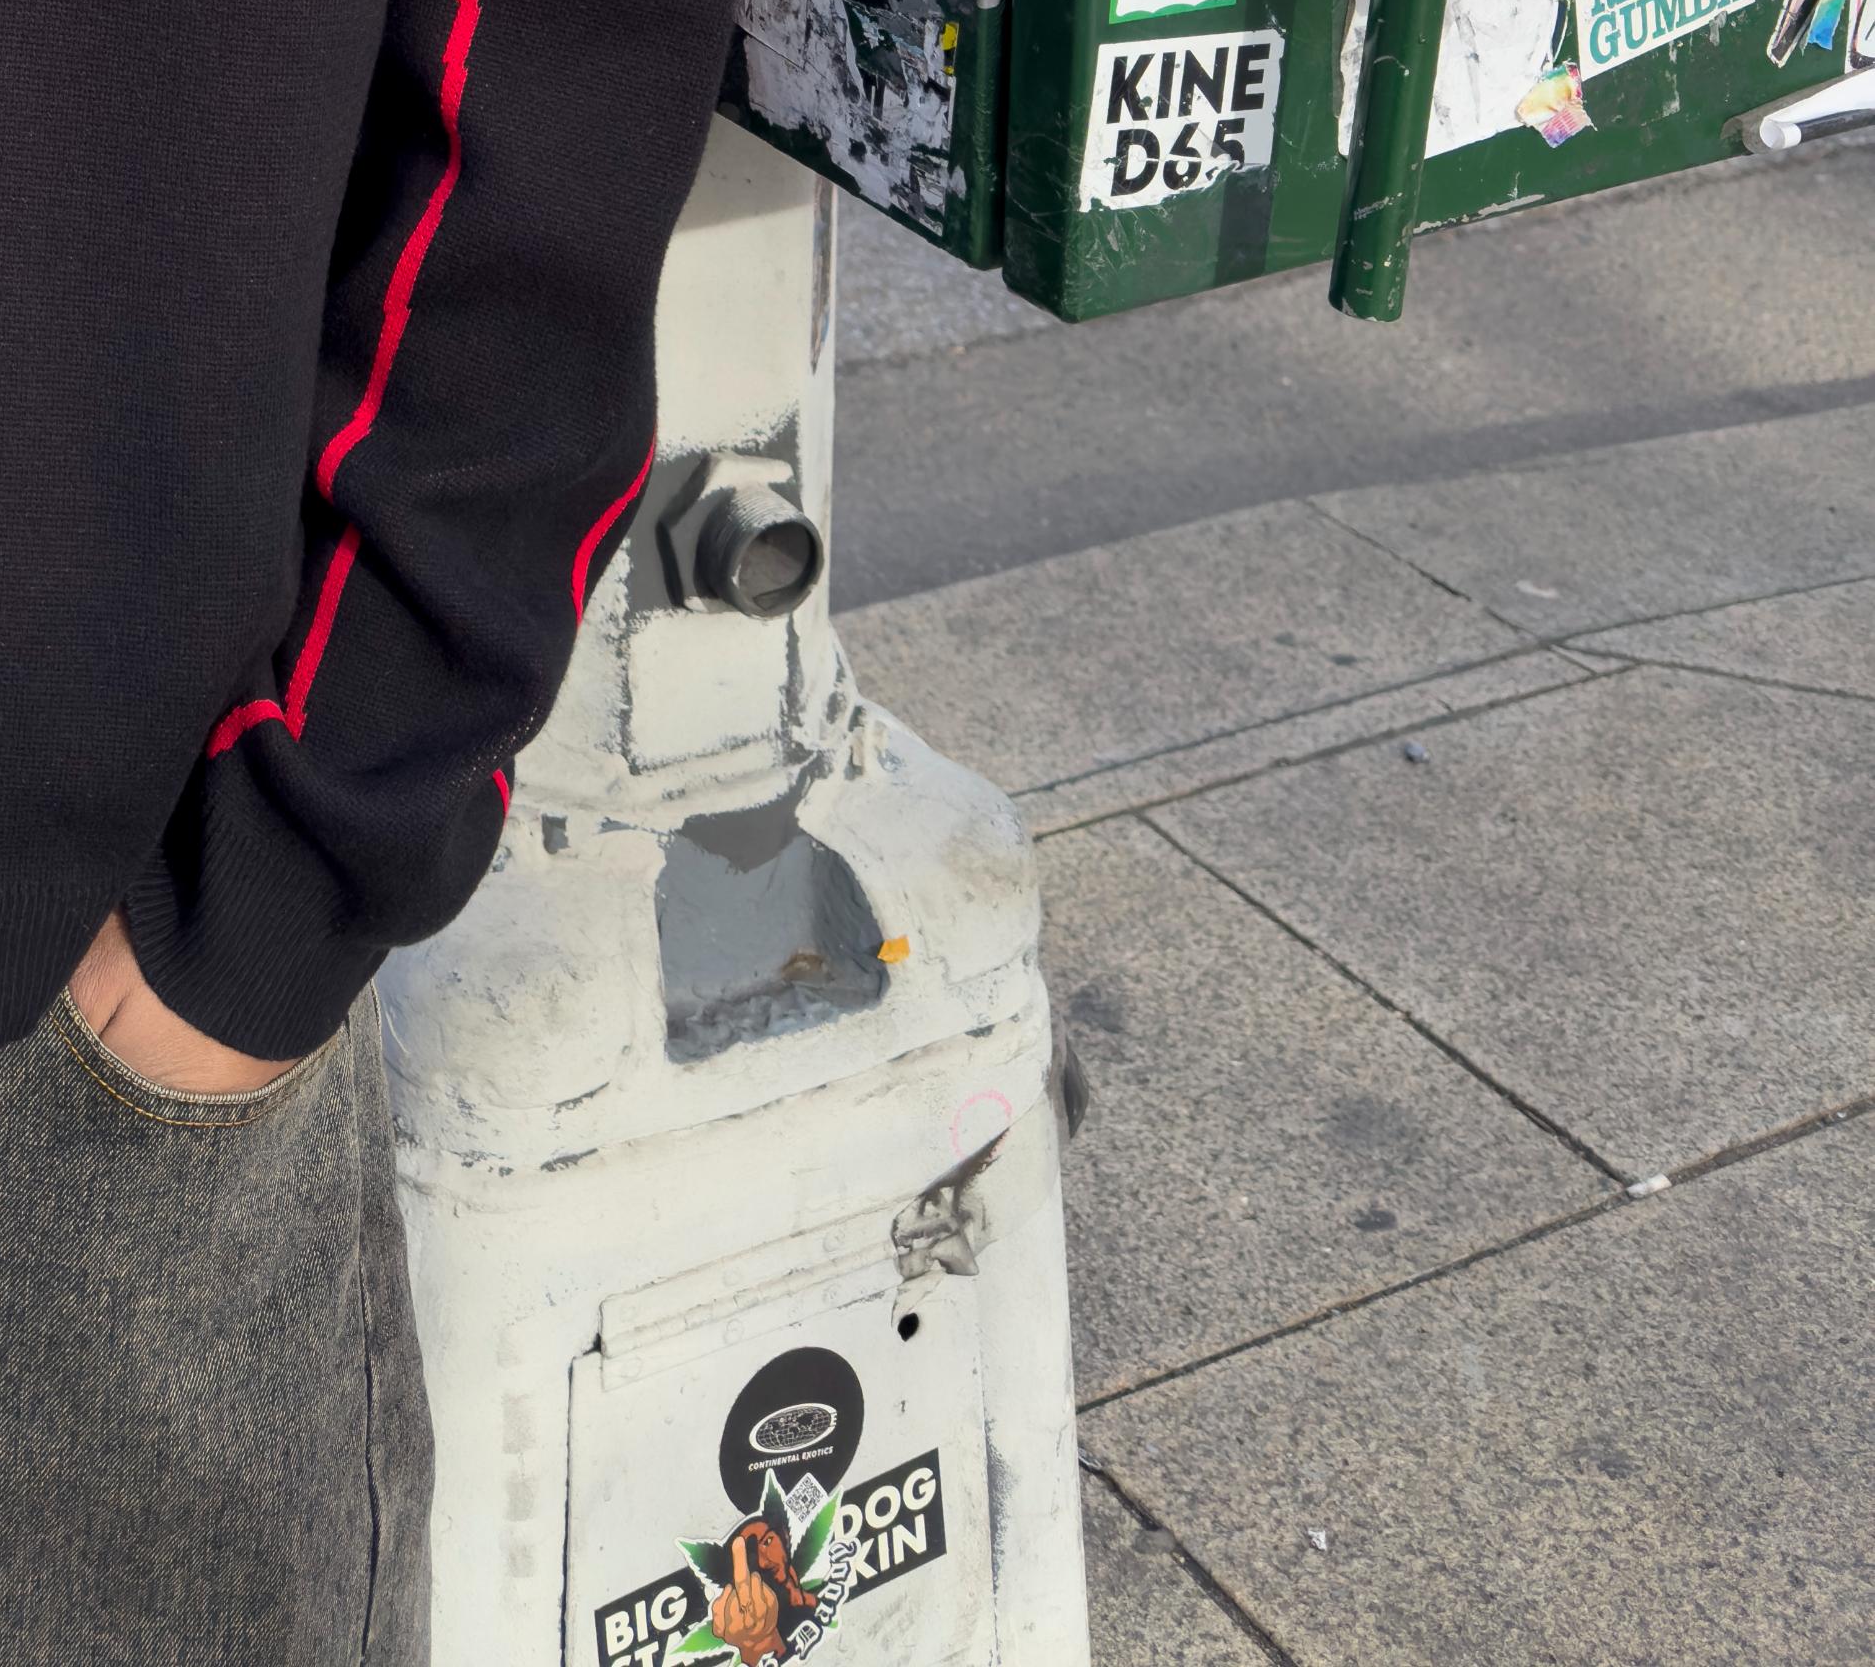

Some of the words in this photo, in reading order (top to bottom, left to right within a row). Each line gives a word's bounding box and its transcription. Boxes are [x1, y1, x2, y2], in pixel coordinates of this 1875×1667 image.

[1106, 43, 1270, 125] KINE
[748, 1454, 800, 1472] CONTINENTAL
[802, 1446, 834, 1462] EXOTICS
[834, 1467, 937, 1543] DOG
[605, 1585, 688, 1657] BIG
